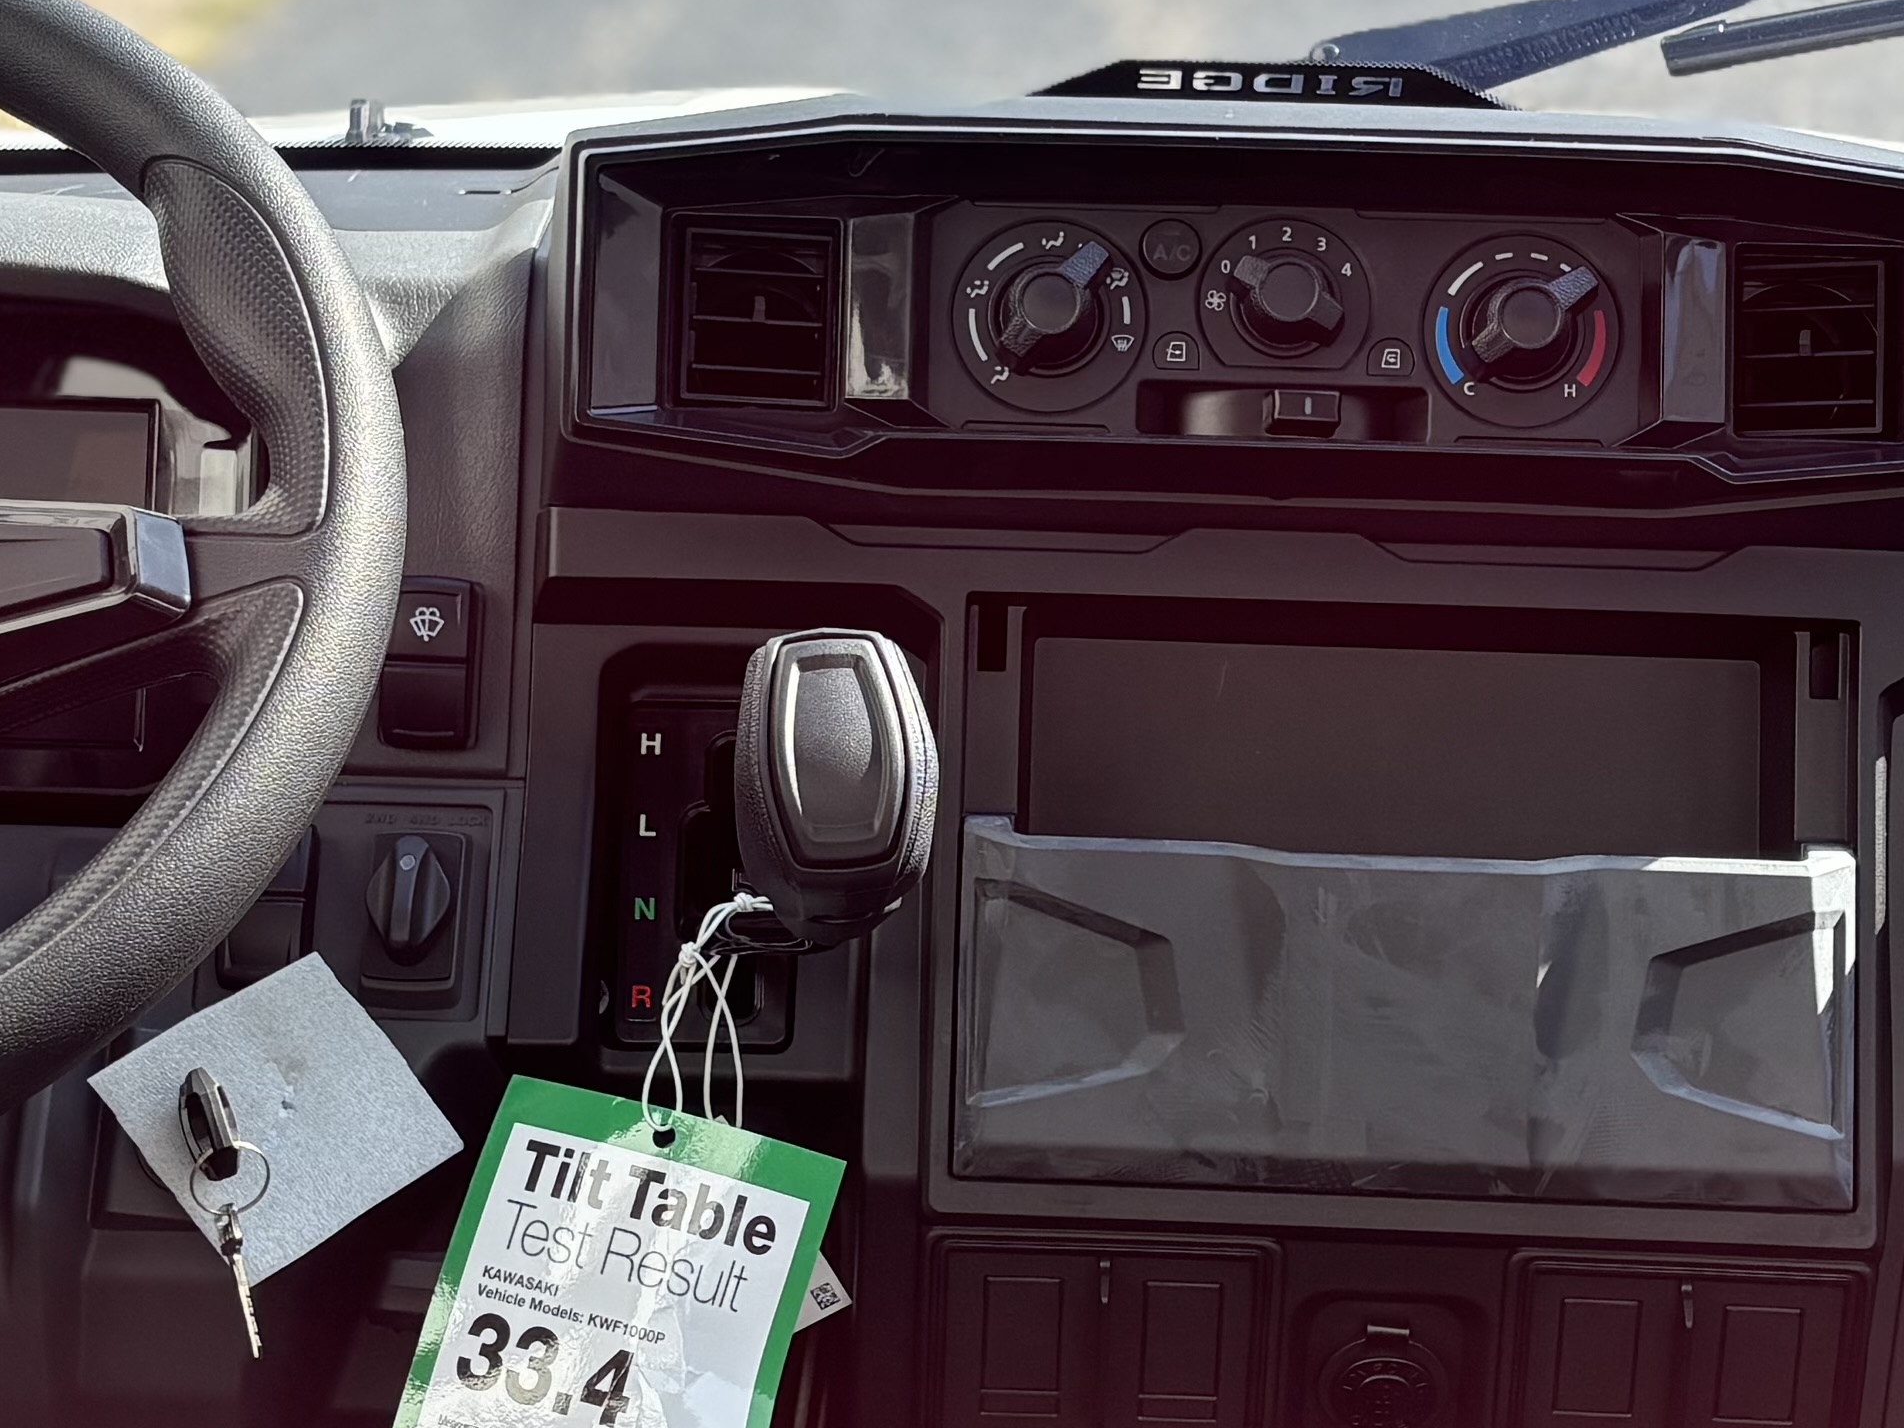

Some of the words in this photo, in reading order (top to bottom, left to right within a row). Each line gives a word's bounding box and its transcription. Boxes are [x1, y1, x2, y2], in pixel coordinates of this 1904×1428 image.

[1248, 235, 1256, 249] 1
[1282, 227, 1292, 242] 2
[1317, 237, 1327, 251] 3
[1153, 244, 1191, 261] A/C
[1221, 260, 1231, 273] 0
[1341, 263, 1352, 276] 4
[1463, 382, 1474, 396] C
[1564, 383, 1576, 398] H
[640, 733, 661, 756] H
[639, 814, 656, 837] L
[634, 898, 655, 921] N
[631, 986, 652, 1008] R
[523, 1139, 610, 1210] Tilt
[627, 1164, 777, 1255] Table
[505, 1199, 593, 1270] Test
[599, 1227, 748, 1313] Result
[482, 1264, 558, 1296] KAWASAKI
[478, 1282, 525, 1307] Vehicle
[528, 1297, 583, 1323] Models:
[587, 1313, 665, 1344] KWF1000P
[456, 1313, 635, 1428] 33.4
